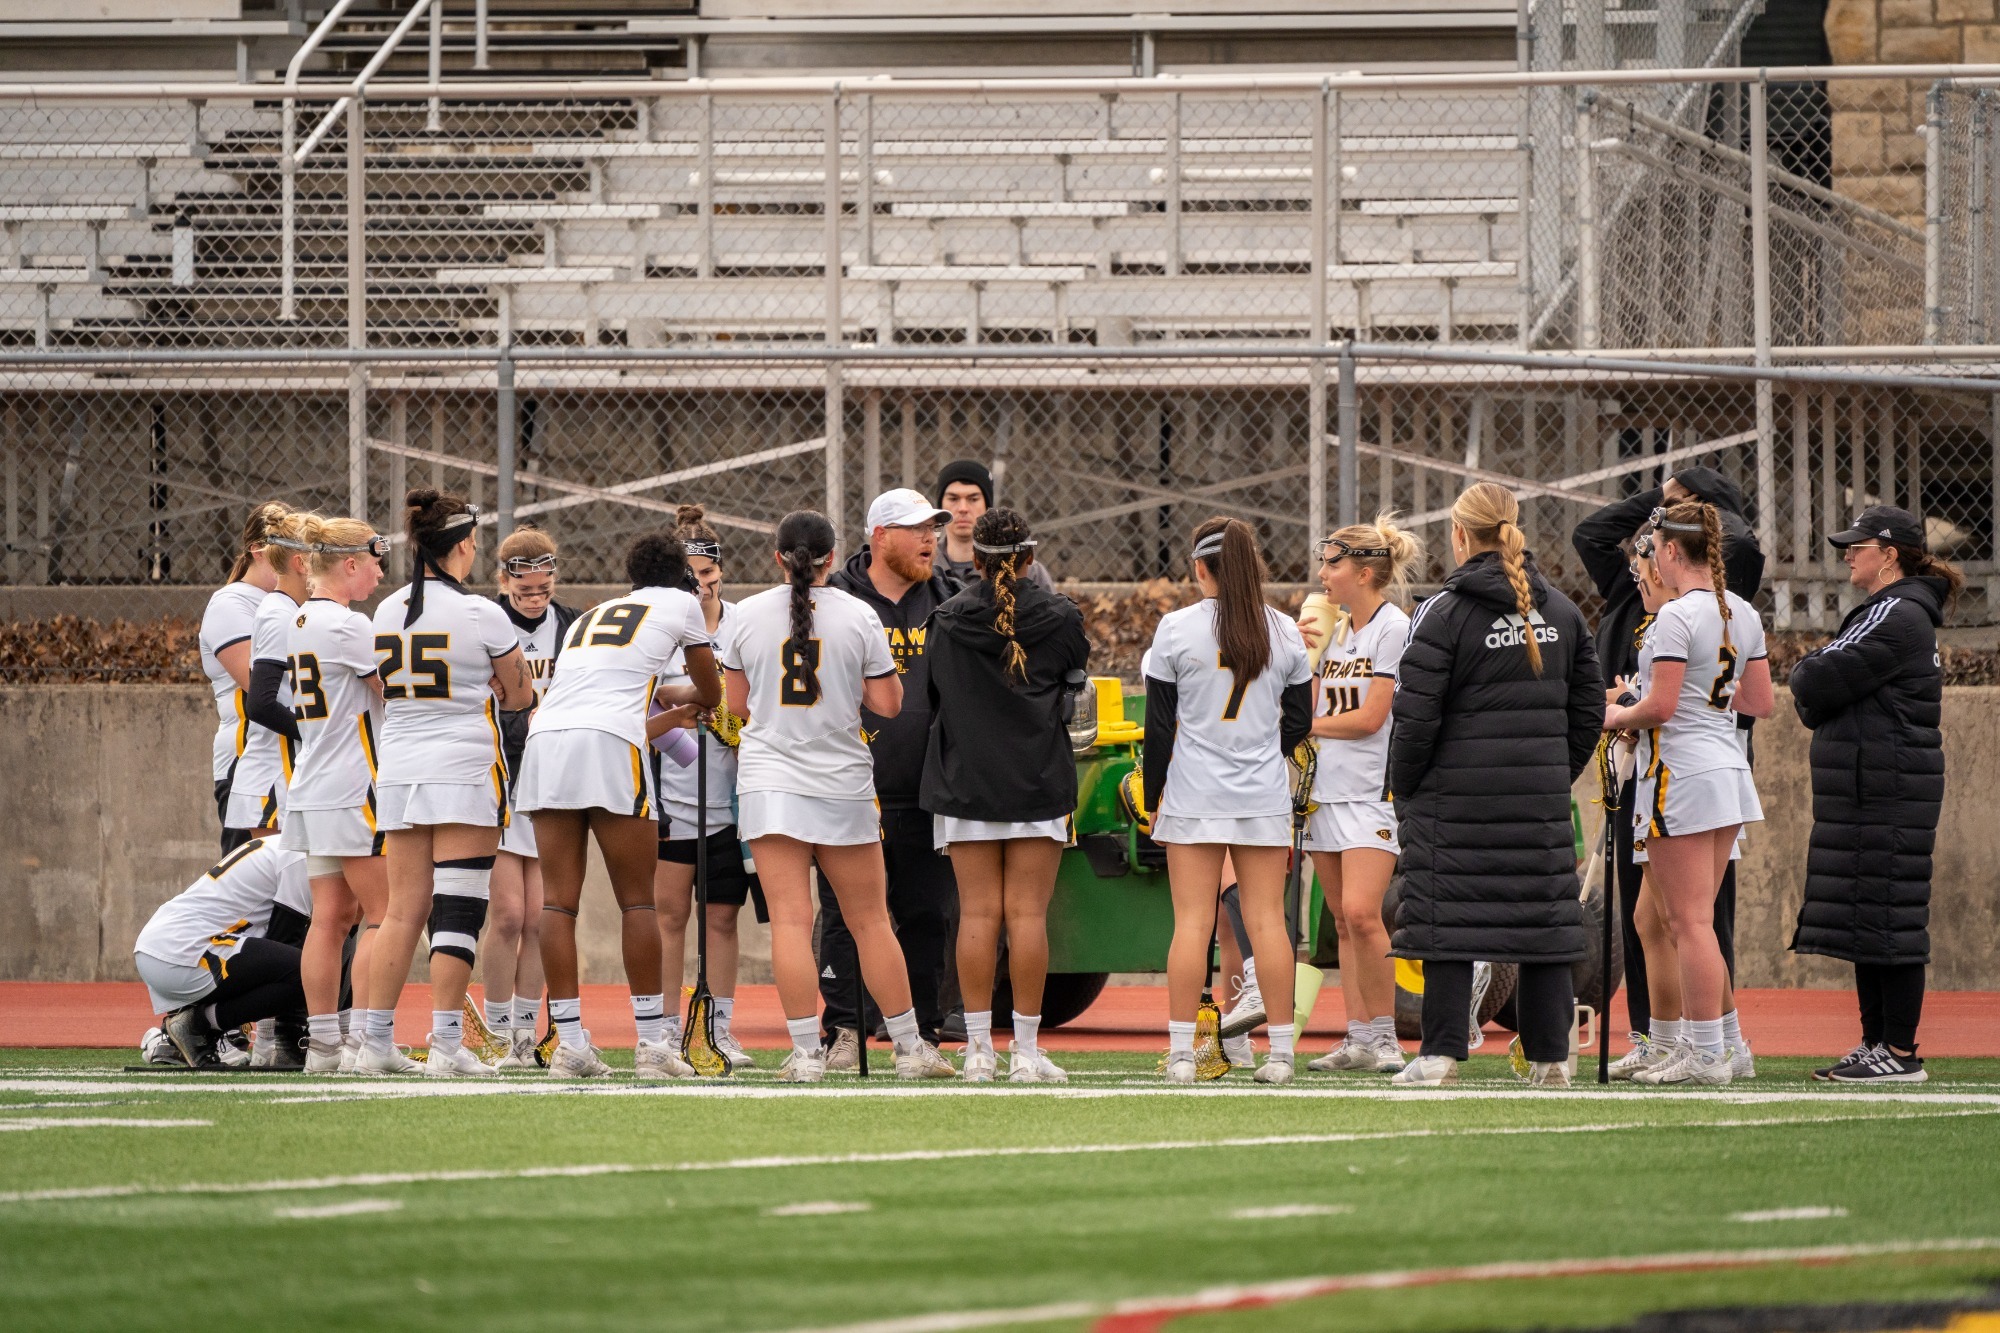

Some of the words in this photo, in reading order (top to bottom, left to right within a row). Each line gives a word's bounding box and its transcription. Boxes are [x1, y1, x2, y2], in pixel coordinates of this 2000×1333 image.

[567, 603, 651, 650] 19
[374, 632, 451, 701] 25
[779, 636, 822, 708] 8
[1217, 650, 1254, 721] 7
[1321, 657, 1374, 679] BRAVES
[1707, 645, 1737, 710] 2
[1325, 686, 1360, 717] 14
